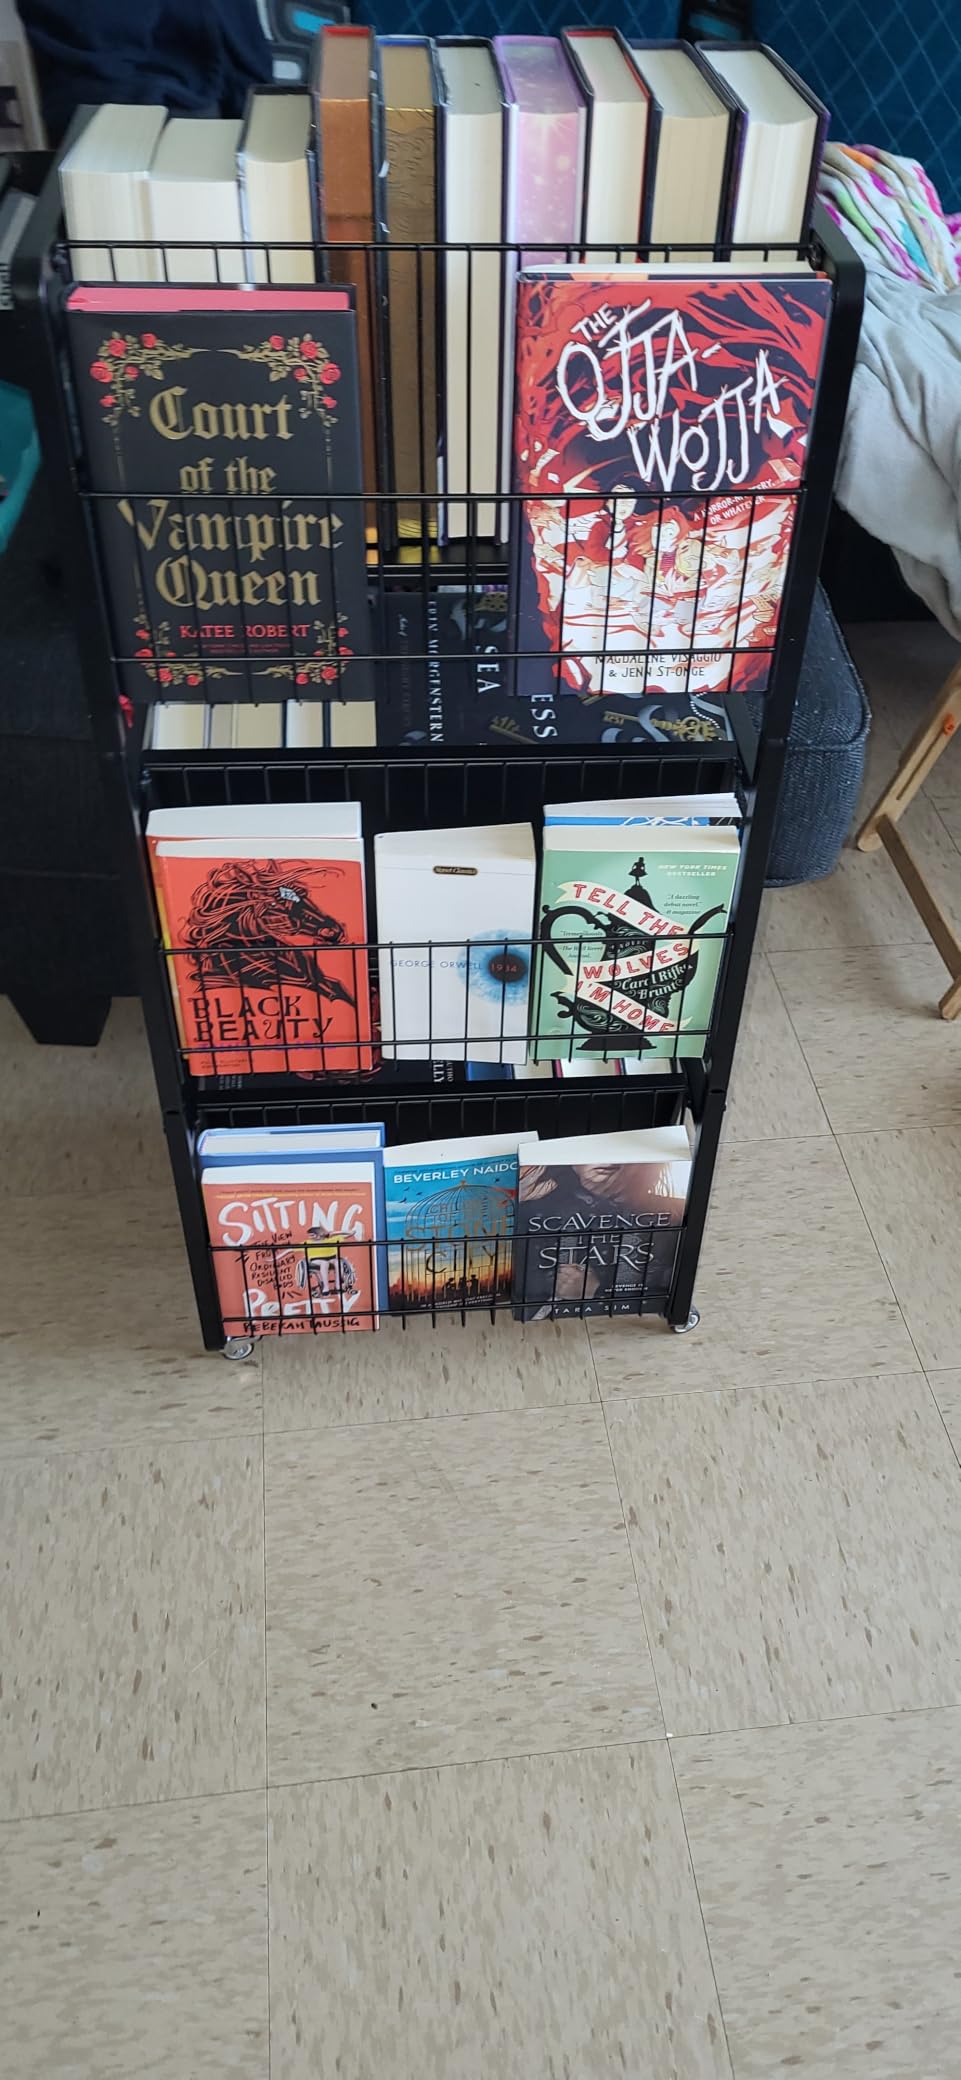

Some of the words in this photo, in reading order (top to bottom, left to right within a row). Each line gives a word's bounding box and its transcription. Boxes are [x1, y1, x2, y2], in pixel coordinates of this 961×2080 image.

[571, 303, 613, 342] THE
[149, 385, 295, 440] Court
[179, 457, 216, 494] of
[223, 456, 278, 494] the
[116, 499, 344, 563] Vampire
[710, 514, 722, 525] OR
[155, 555, 322, 610] Queen
[474, 645, 501, 693] SEA
[595, 654, 666, 665] MAGDALNE
[608, 669, 617, 678] &
[573, 883, 630, 916] TELL
[637, 910, 685, 936] THE
[583, 943, 689, 979] WOLVES
[191, 995, 303, 1019] BLACK
[576, 980, 612, 1003] I'M
[613, 999, 676, 1033] HOME
[191, 1016, 334, 1042] BEAUTY
[393, 1168, 469, 1183] BEVERLEY
[218, 1197, 364, 1247] SITTING
[528, 1211, 672, 1232] SCAVENGE
[272, 1231, 293, 1243] VIEW
[577, 1233, 622, 1245] THE
[538, 1242, 656, 1272] STARS
[309, 1317, 361, 1329] TAUSIG
[554, 1306, 593, 1315] TARA
